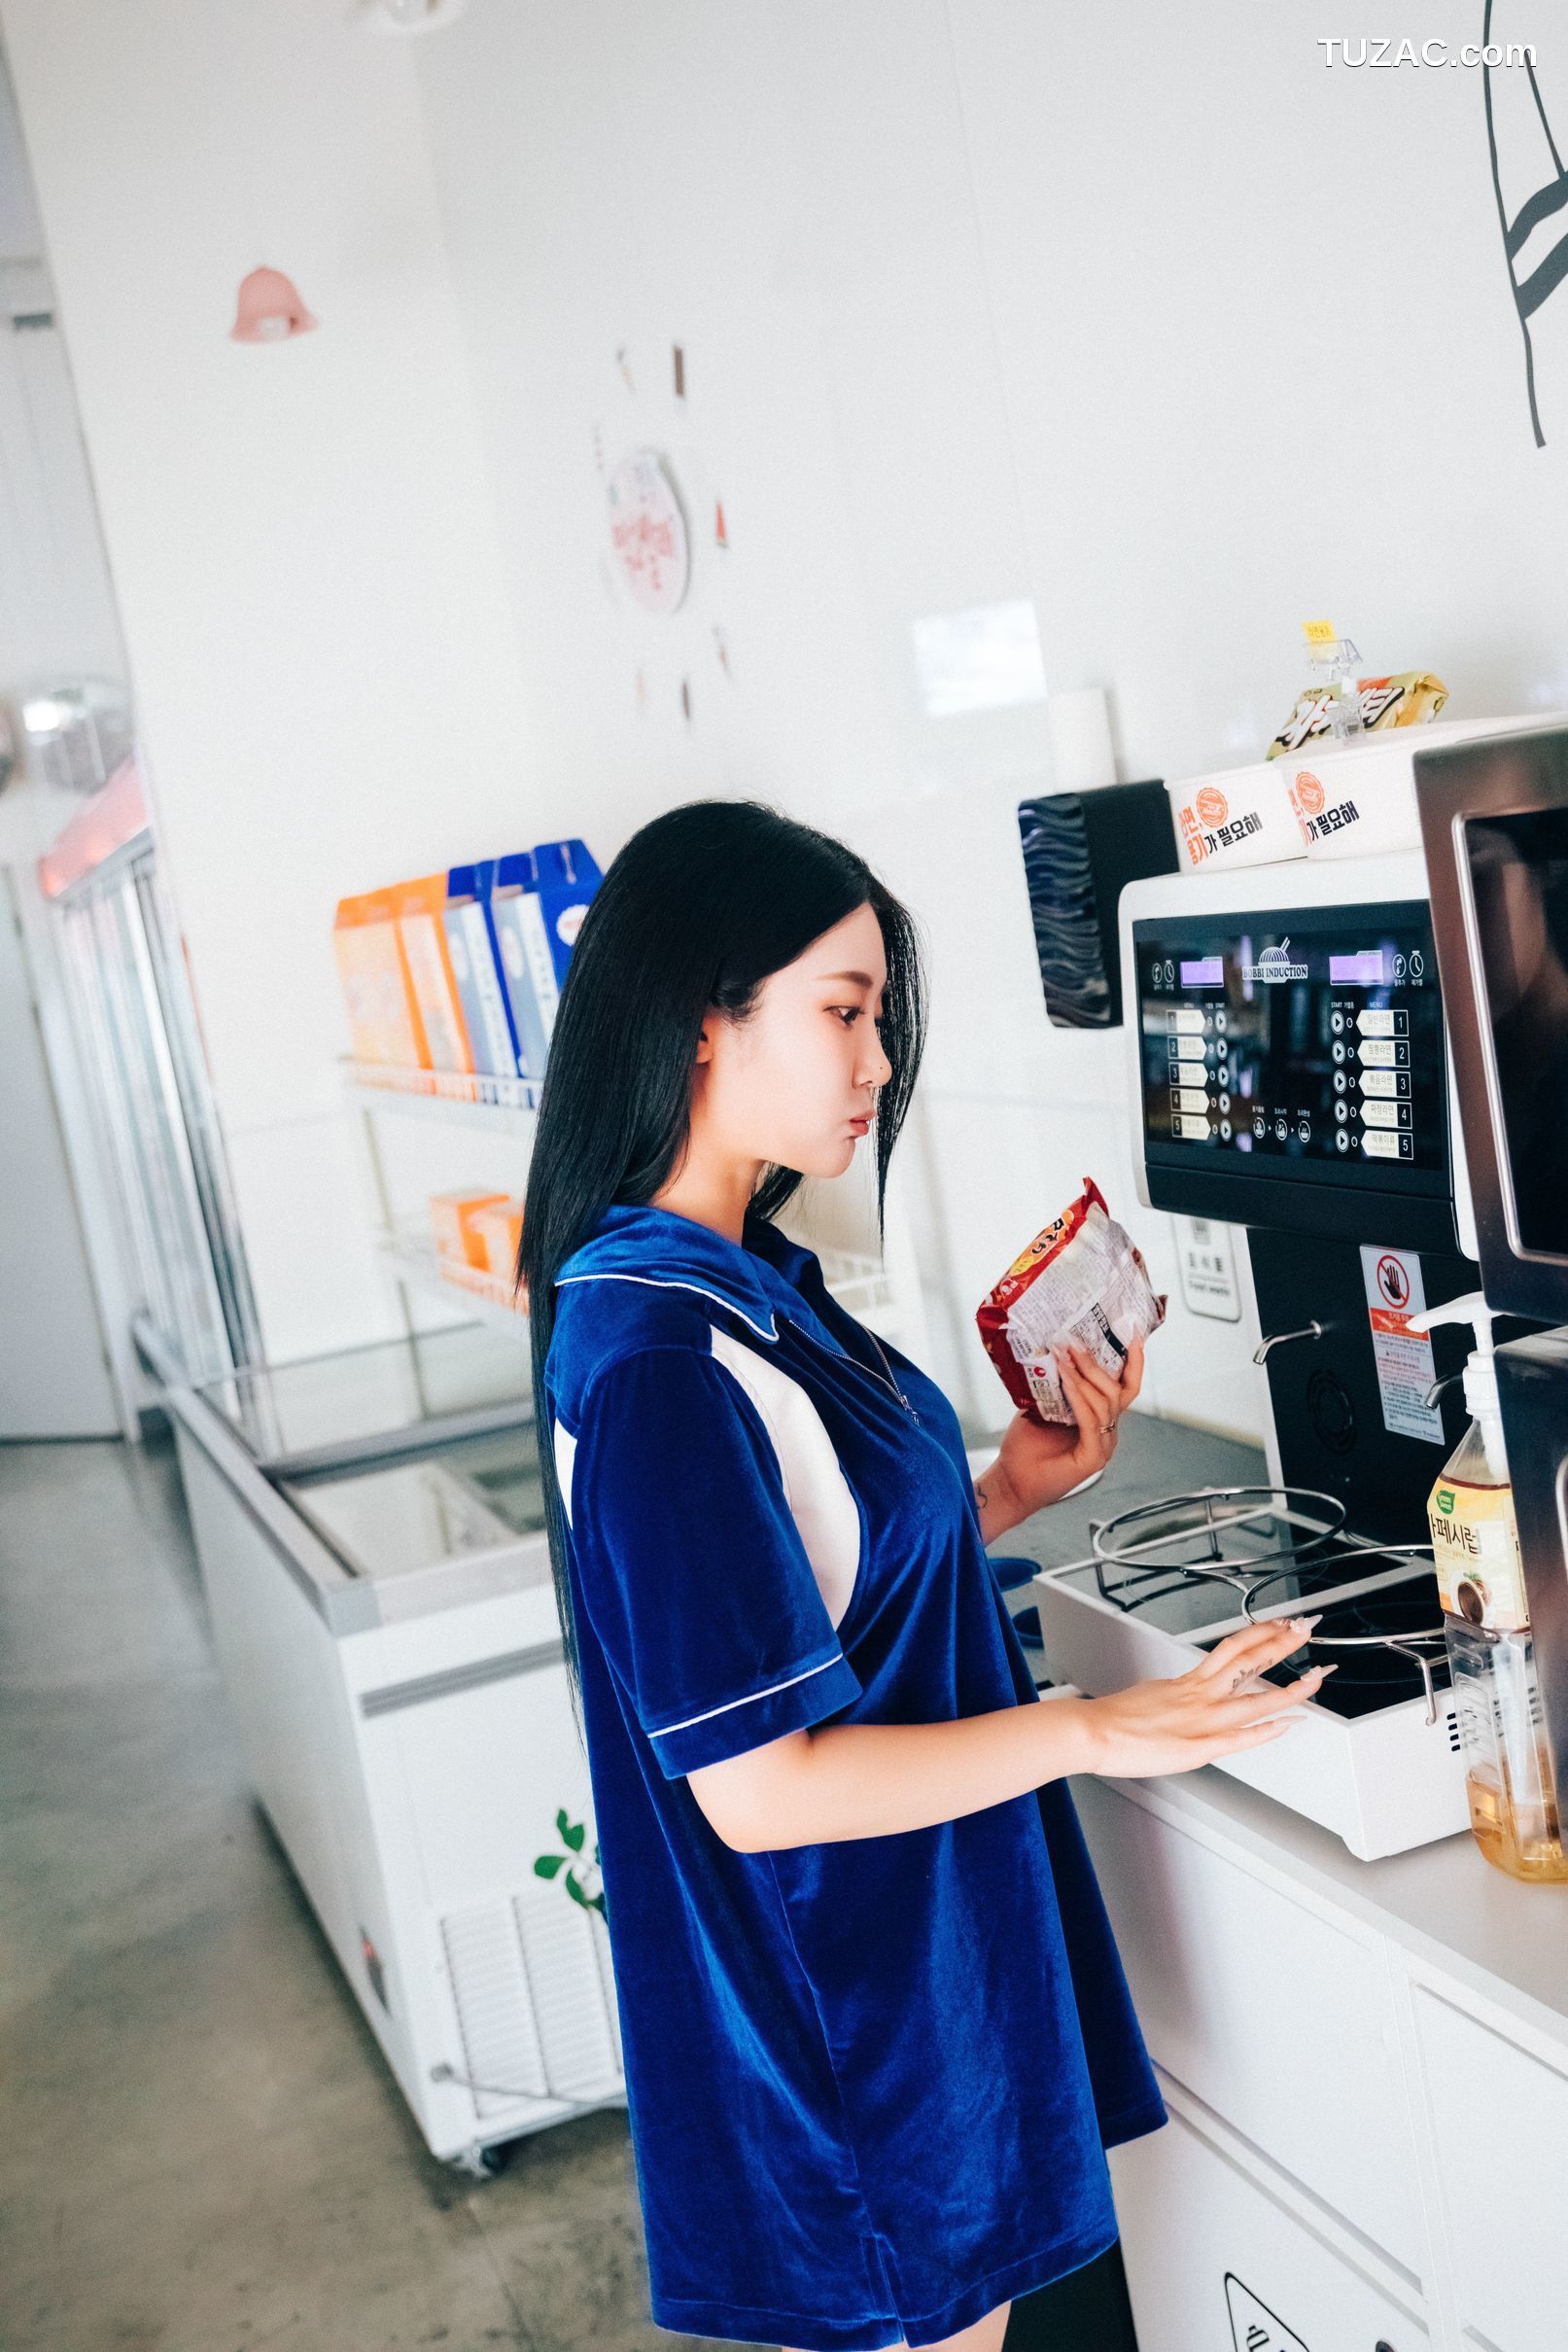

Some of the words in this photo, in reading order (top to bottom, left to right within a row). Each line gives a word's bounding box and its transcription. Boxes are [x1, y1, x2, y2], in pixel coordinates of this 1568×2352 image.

[1315, 800, 1360, 836] 필요해
[1187, 833, 1218, 865] 용기가
[1217, 811, 1264, 847] 필요해
[1242, 966, 1265, 979] BOBBI
[1266, 965, 1307, 978] INDUCTION
[1398, 1016, 1403, 1029] 1
[1399, 1047, 1406, 1060] 2
[1400, 1077, 1407, 1090] 3
[1173, 1094, 1179, 1105] 4
[1401, 1108, 1408, 1121] 4
[1174, 1120, 1180, 1131] 5
[1402, 1140, 1409, 1151] 5
